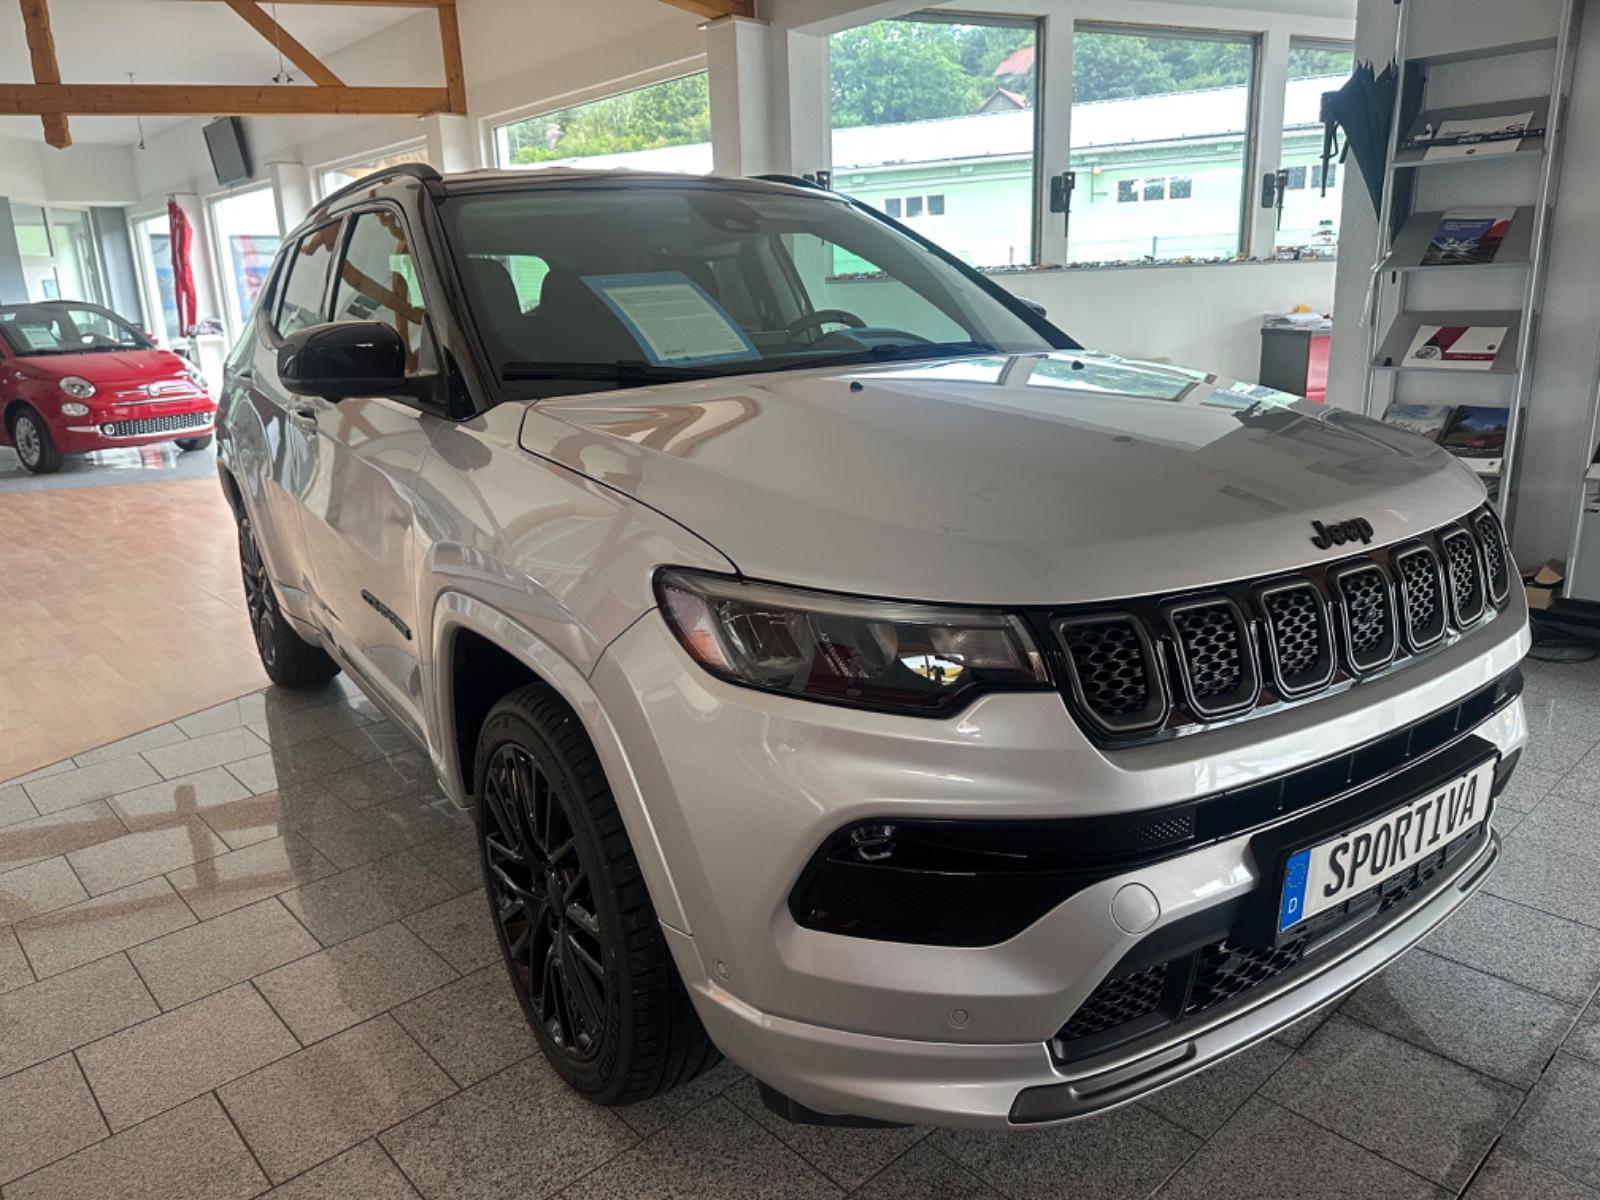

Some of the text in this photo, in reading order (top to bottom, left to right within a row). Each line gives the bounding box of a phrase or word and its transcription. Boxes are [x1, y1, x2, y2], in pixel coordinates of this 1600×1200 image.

[1311, 517, 1373, 550] Jeep
[1323, 773, 1479, 898] SPORTIVA
[1288, 897, 1298, 914] D
